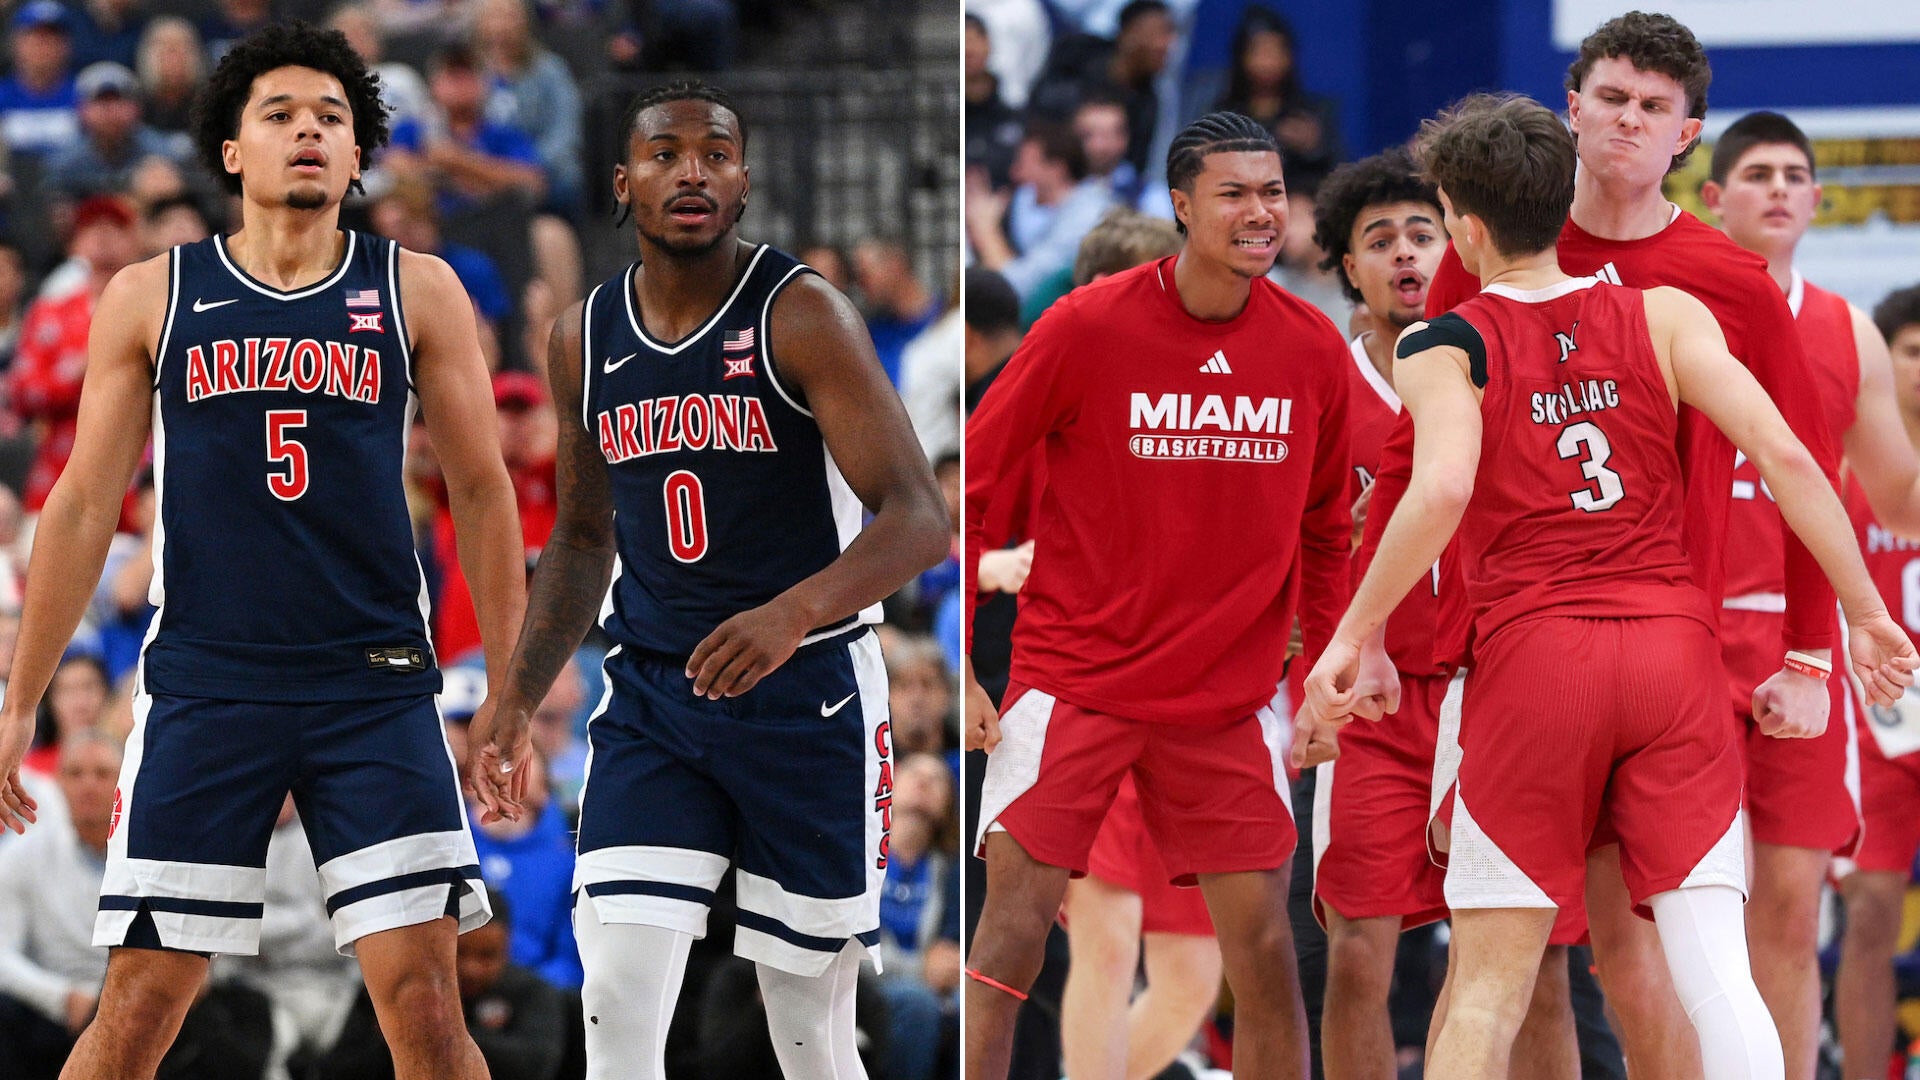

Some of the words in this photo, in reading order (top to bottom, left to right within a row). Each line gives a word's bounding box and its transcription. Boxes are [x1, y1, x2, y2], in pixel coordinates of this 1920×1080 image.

[186, 337, 382, 404] ARIZONA
[724, 354, 755, 380] XII
[597, 393, 779, 464] ARIZONA
[1129, 392, 1293, 435] MIAMI
[1142, 438, 1275, 460] BASKETBALL
[265, 409, 310, 502] 5
[1555, 420, 1626, 513] 3
[663, 469, 709, 564] 0
[874, 720, 894, 870] CATS
